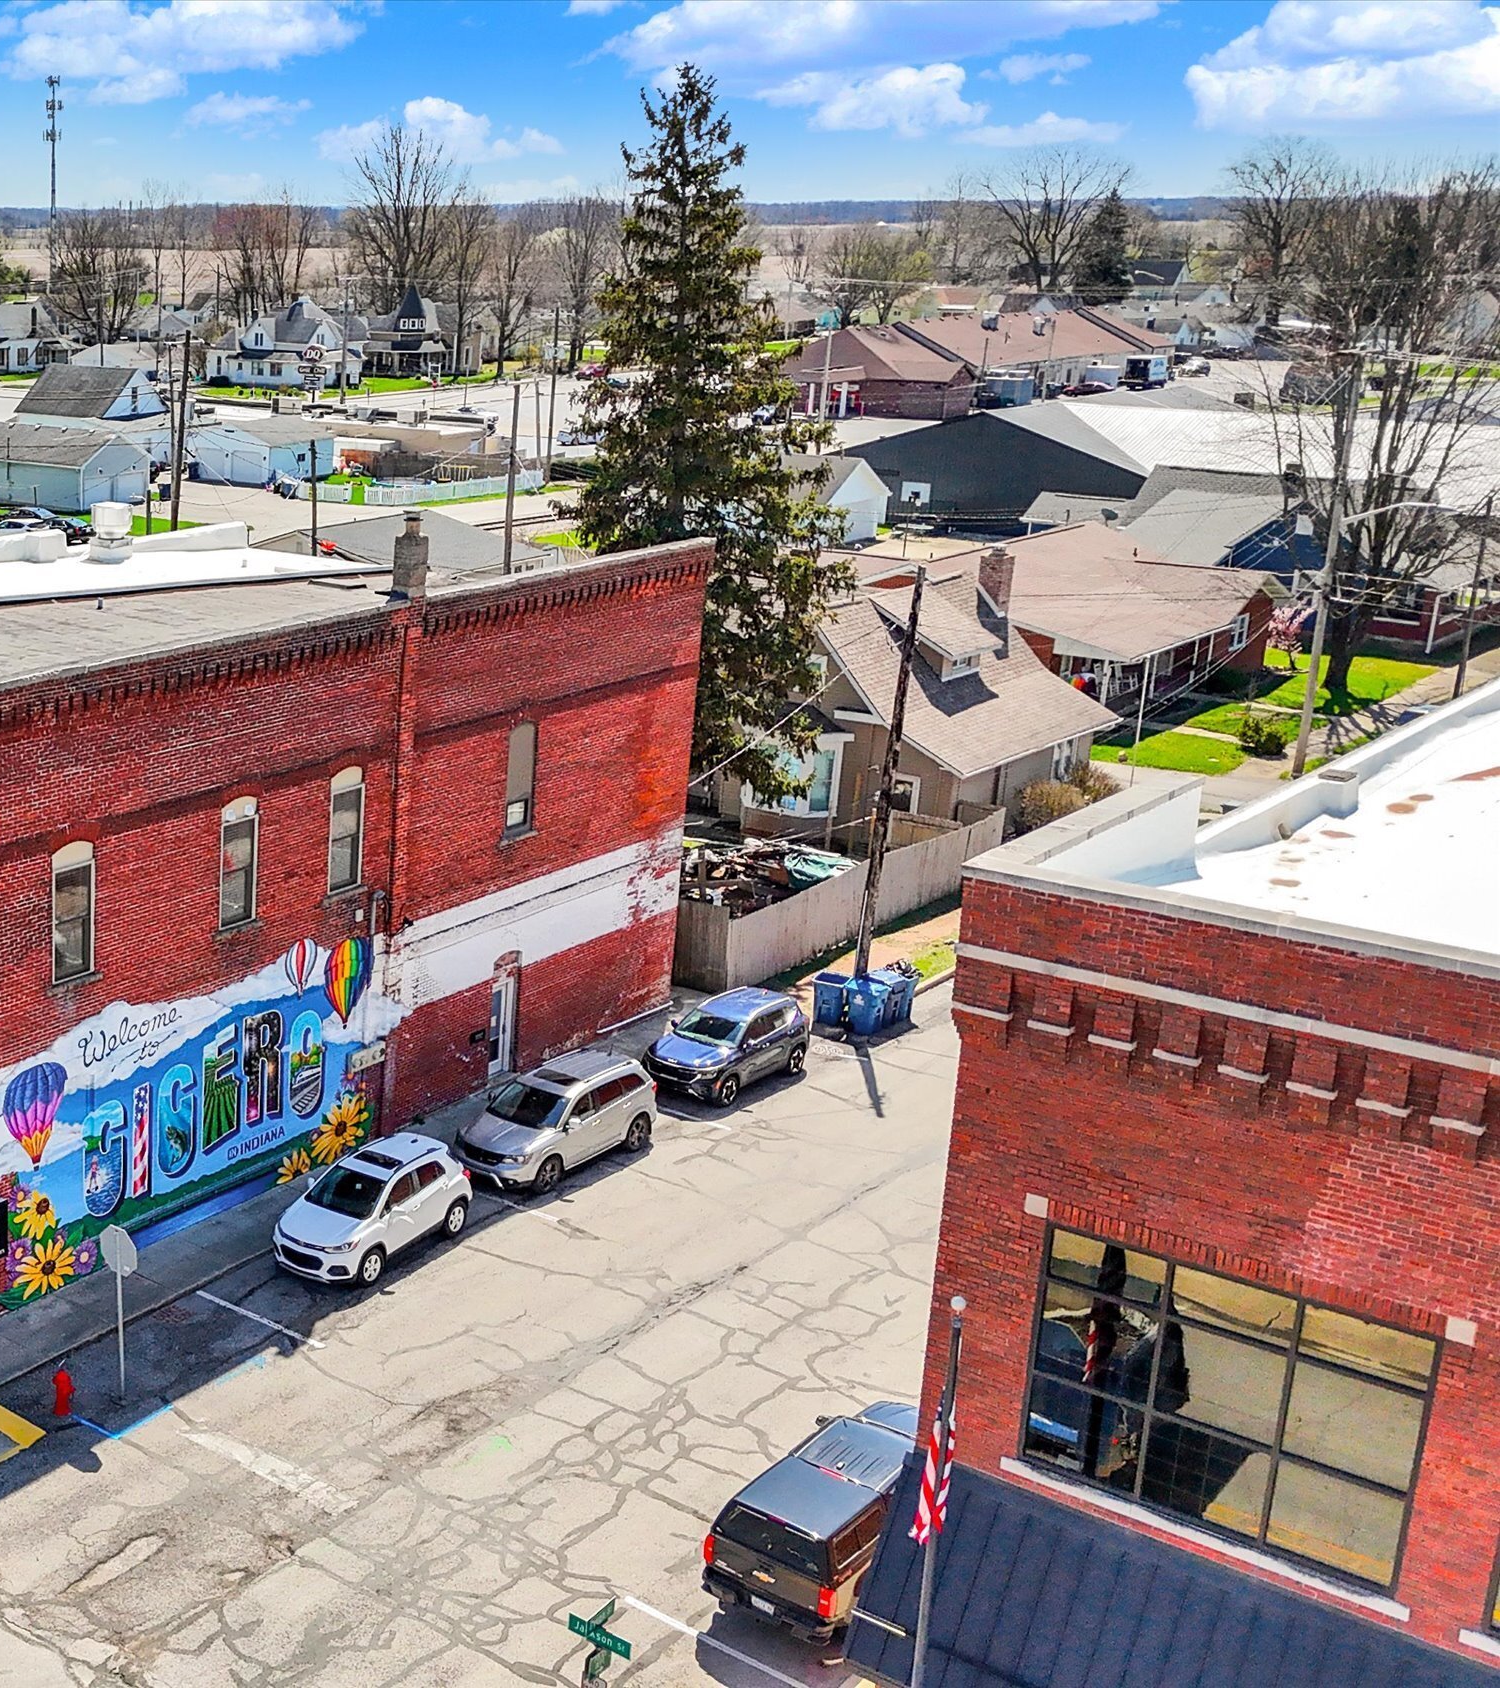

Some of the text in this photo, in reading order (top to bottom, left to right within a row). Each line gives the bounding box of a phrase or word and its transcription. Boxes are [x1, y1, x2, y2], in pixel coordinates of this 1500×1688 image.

[306, 350, 321, 360] DQ
[77, 1007, 182, 1068] Welcome
[81, 1009, 328, 1218] CICERO
[240, 1125, 286, 1156] INDIANA
[573, 1620, 613, 1646] Jason
